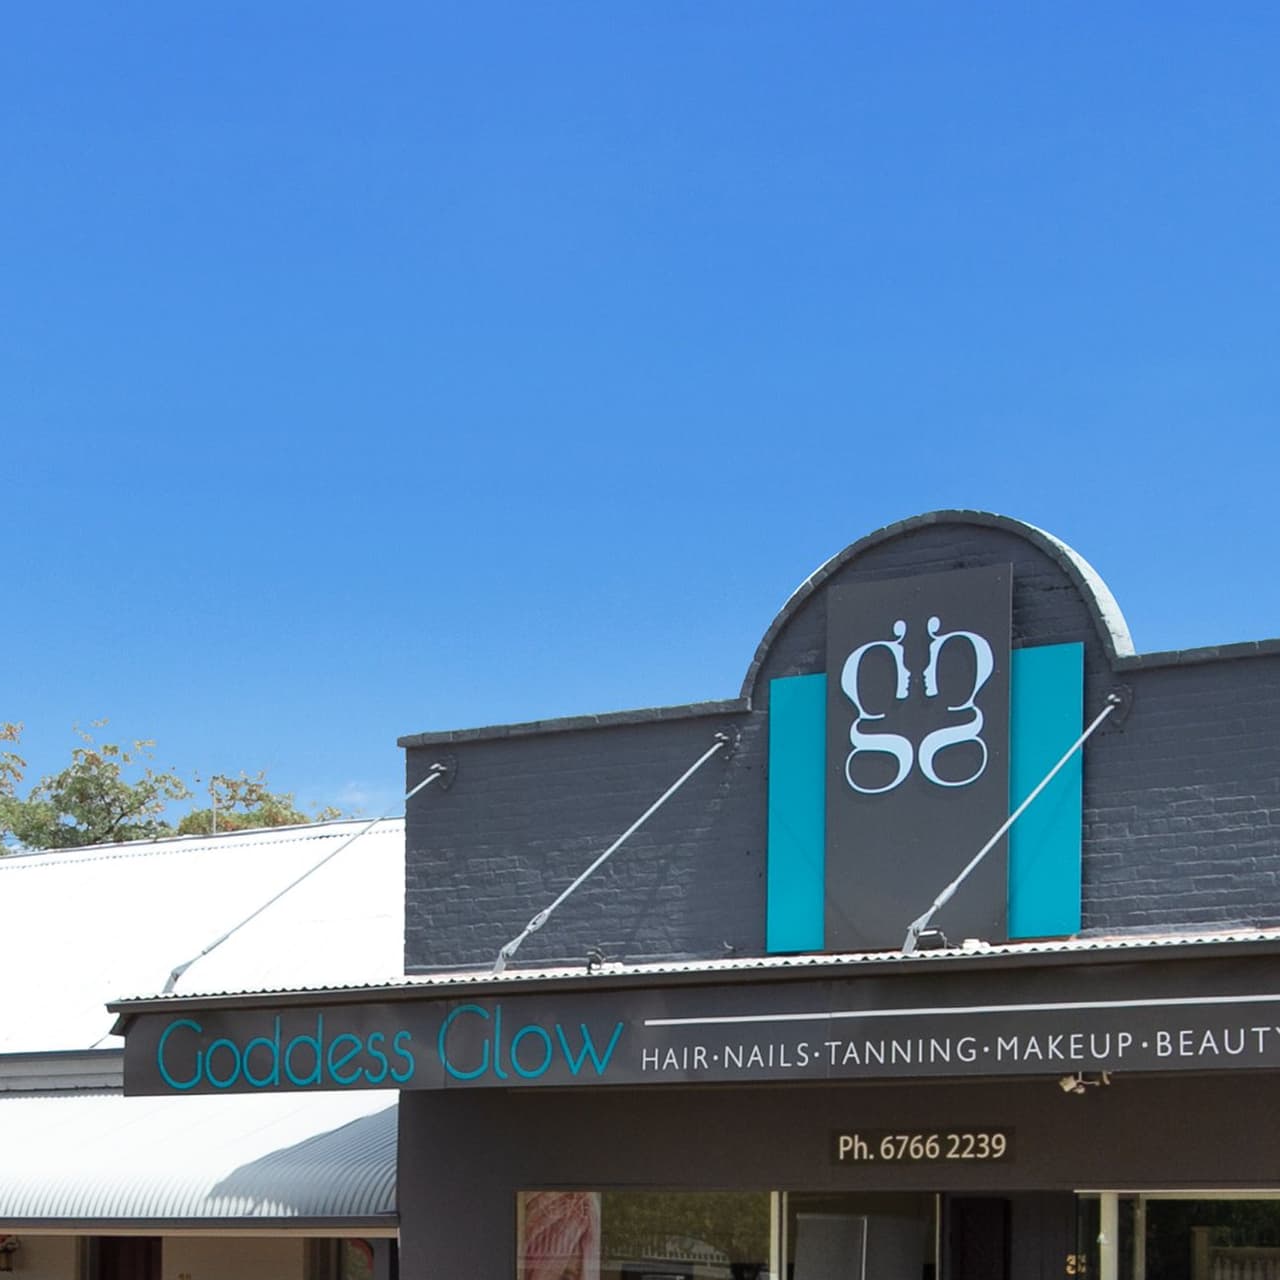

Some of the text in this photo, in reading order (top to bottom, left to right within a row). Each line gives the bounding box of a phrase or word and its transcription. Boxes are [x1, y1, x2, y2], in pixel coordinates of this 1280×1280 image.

[157, 1003, 624, 1090] Goddess Glow
[641, 1047, 708, 1072] HAIR
[724, 1042, 810, 1068] NAILS
[824, 1036, 978, 1067] TANNING
[996, 1032, 1132, 1061] MAKEUP
[838, 1133, 1007, 1160] Ph. 6766 2239
